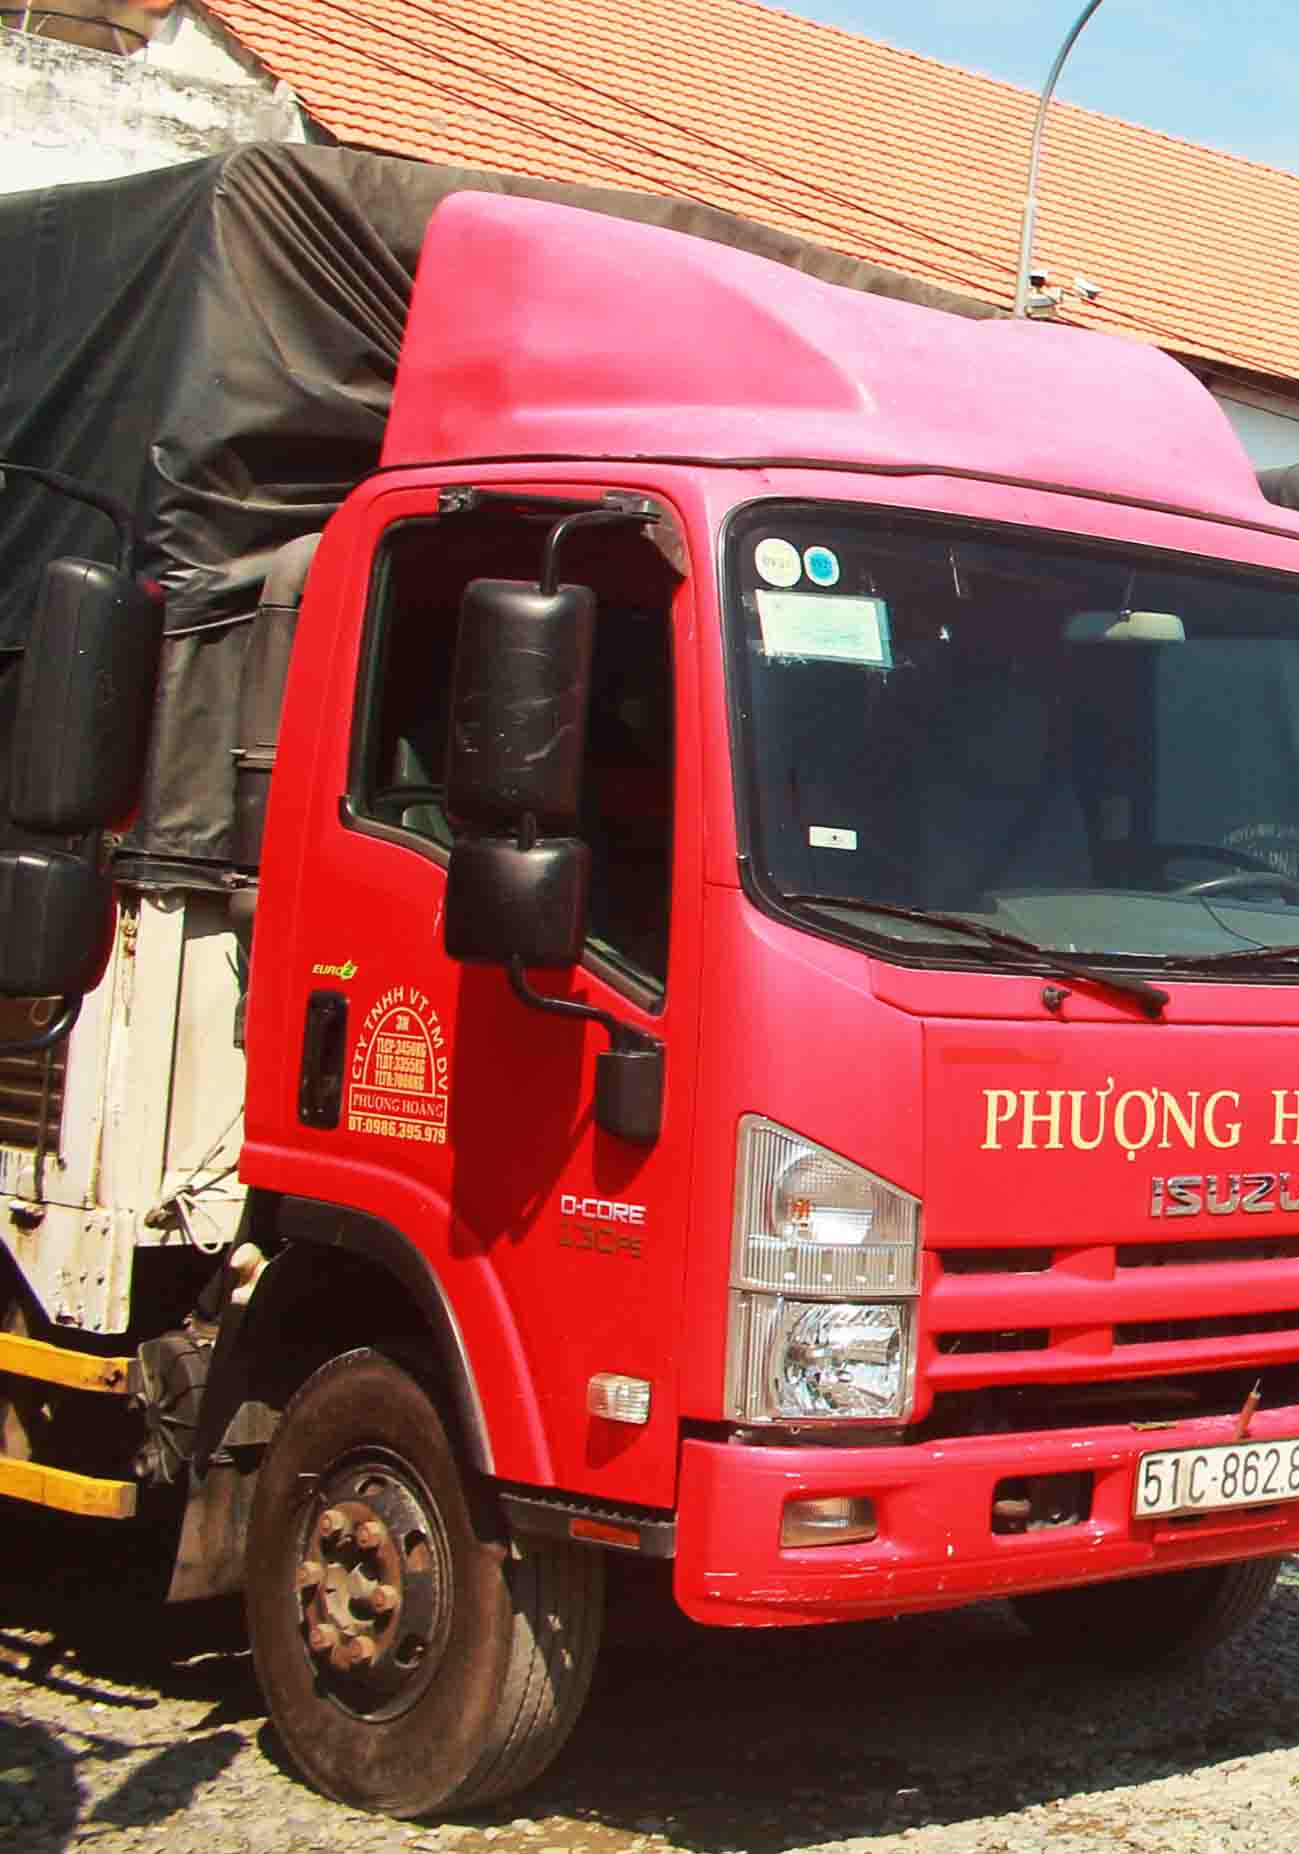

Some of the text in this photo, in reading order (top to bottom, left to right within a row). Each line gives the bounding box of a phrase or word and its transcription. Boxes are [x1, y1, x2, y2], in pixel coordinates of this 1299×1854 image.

[352, 986, 448, 1091] CTY TNHH VT TM DV
[980, 1077, 1242, 1161] PHƯỢNG
[560, 1194, 647, 1225] D-CORE
